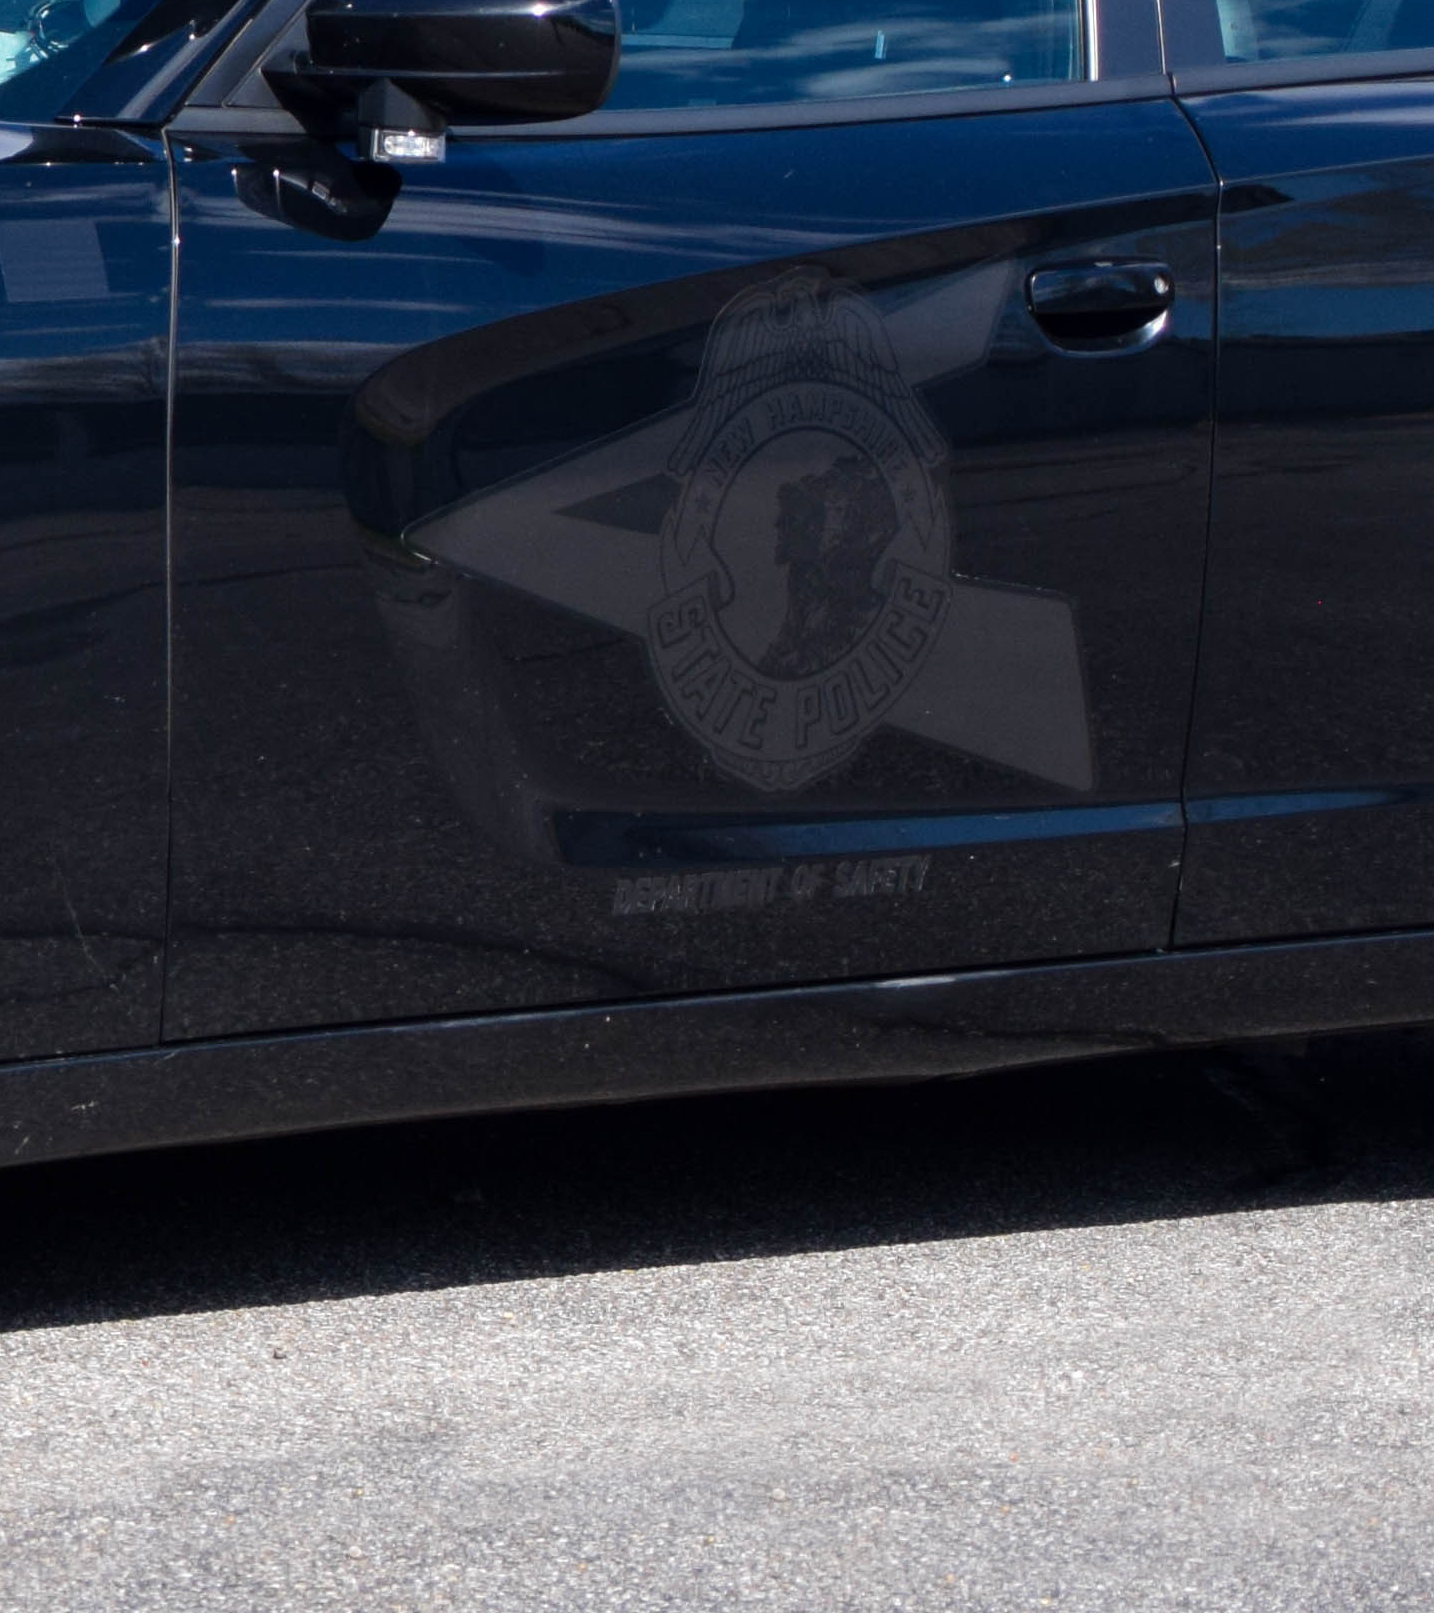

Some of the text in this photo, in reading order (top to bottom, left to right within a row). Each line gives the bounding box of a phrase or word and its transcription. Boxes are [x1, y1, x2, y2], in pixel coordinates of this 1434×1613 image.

[711, 418, 755, 488] NEW
[655, 573, 946, 751] STATE POLICE
